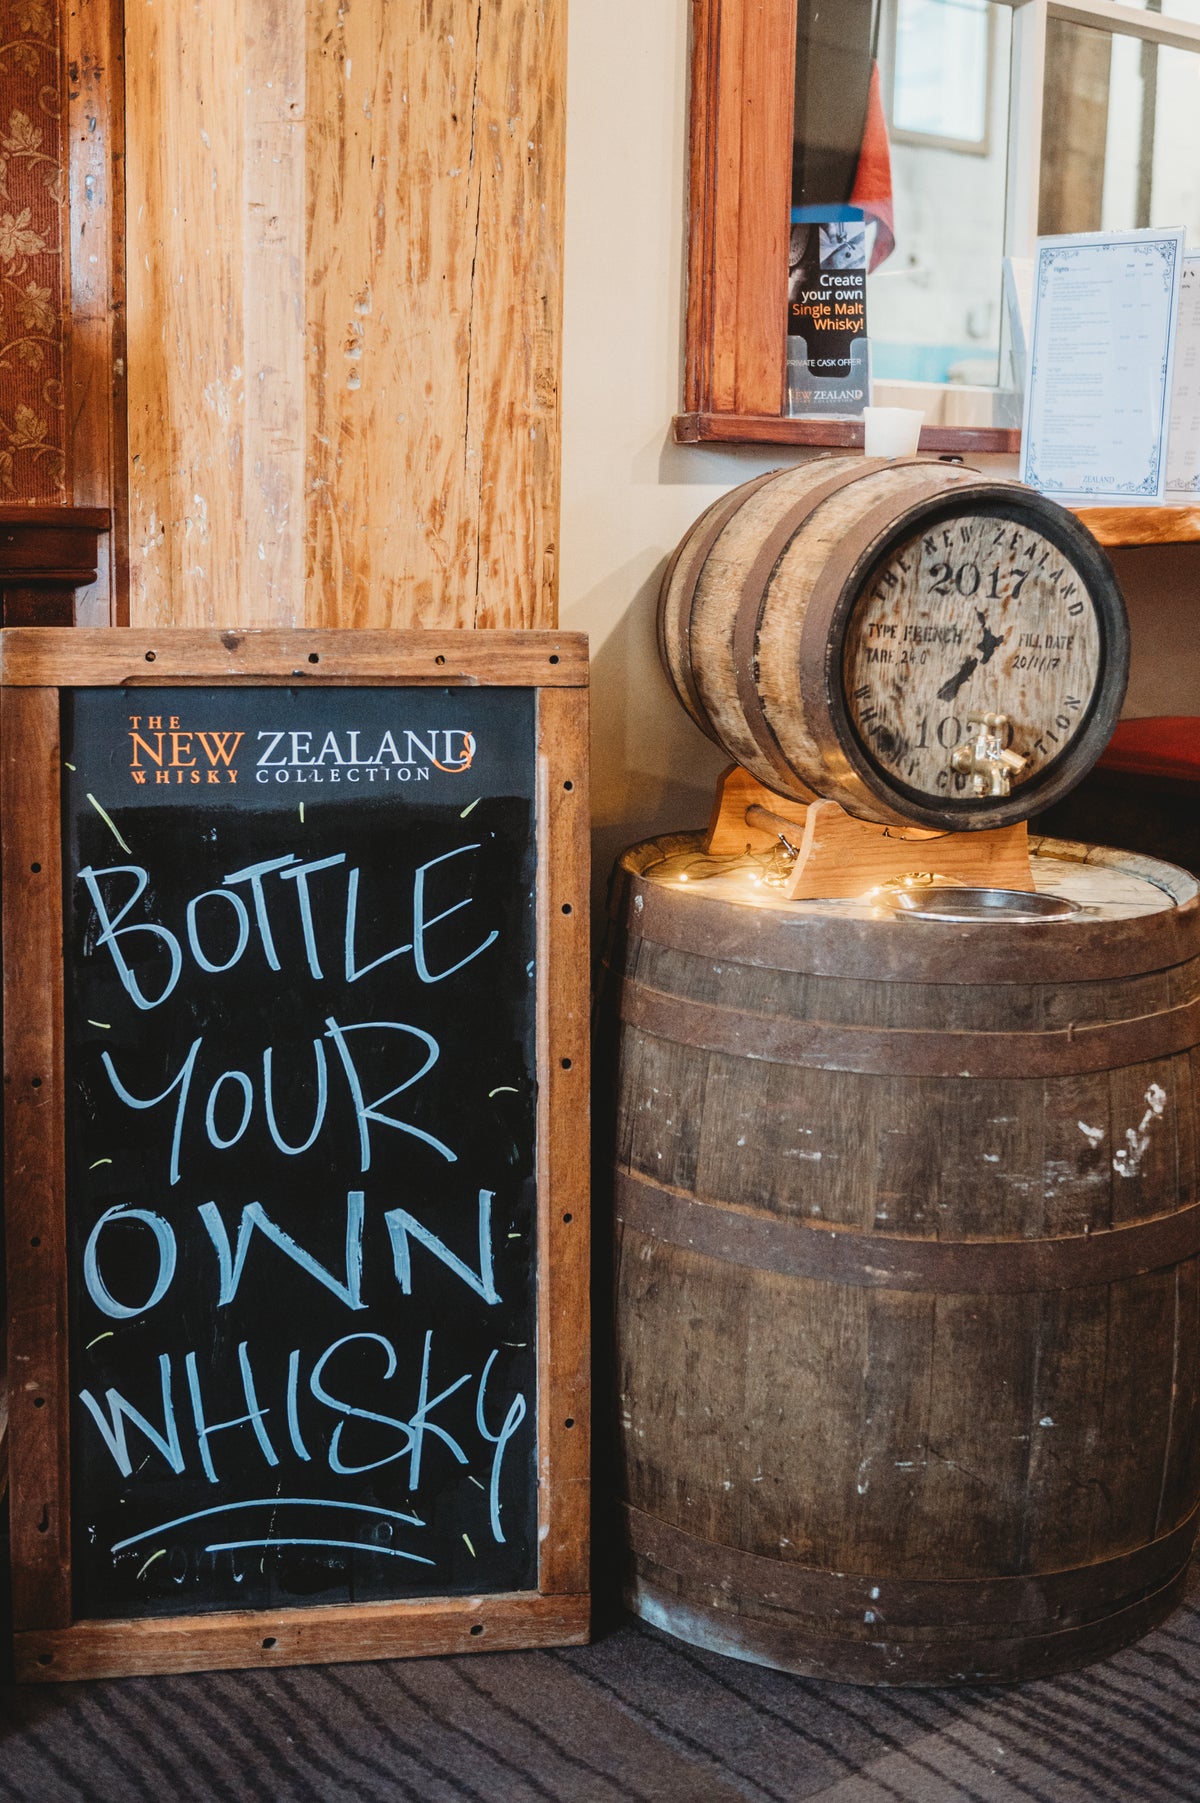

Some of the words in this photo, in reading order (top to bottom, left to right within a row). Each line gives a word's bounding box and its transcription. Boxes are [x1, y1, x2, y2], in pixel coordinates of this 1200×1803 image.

[820, 274, 863, 287] Create
[802, 290, 832, 304] your
[835, 290, 863, 300] own
[792, 303, 832, 318] Single
[834, 303, 863, 315] Malt
[814, 318, 864, 332] Whisky!
[786, 359, 815, 367] PRIVATE
[817, 359, 836, 367] CASK
[837, 358, 862, 366] OFFER
[813, 390, 863, 400] ZEALAND
[870, 558, 911, 601] THE
[922, 526, 974, 556] NEW
[992, 527, 1084, 617] ZEALAND
[928, 562, 1031, 600] 2017
[868, 623, 899, 639] TYPE
[903, 624, 963, 646] FRENCH
[1045, 634, 1074, 650] DATE
[865, 648, 894, 664] TARE
[128, 716, 182, 730] THE
[128, 731, 246, 767] NEW
[256, 729, 477, 773] ZEALAND
[133, 770, 240, 785] WHISKY
[256, 767, 430, 784] COLLECTION
[77, 843, 499, 1010] BOTTLE
[101, 1016, 458, 1185] YOUR
[83, 1188, 503, 1319] OWN
[78, 1329, 527, 1543] WHISKY
